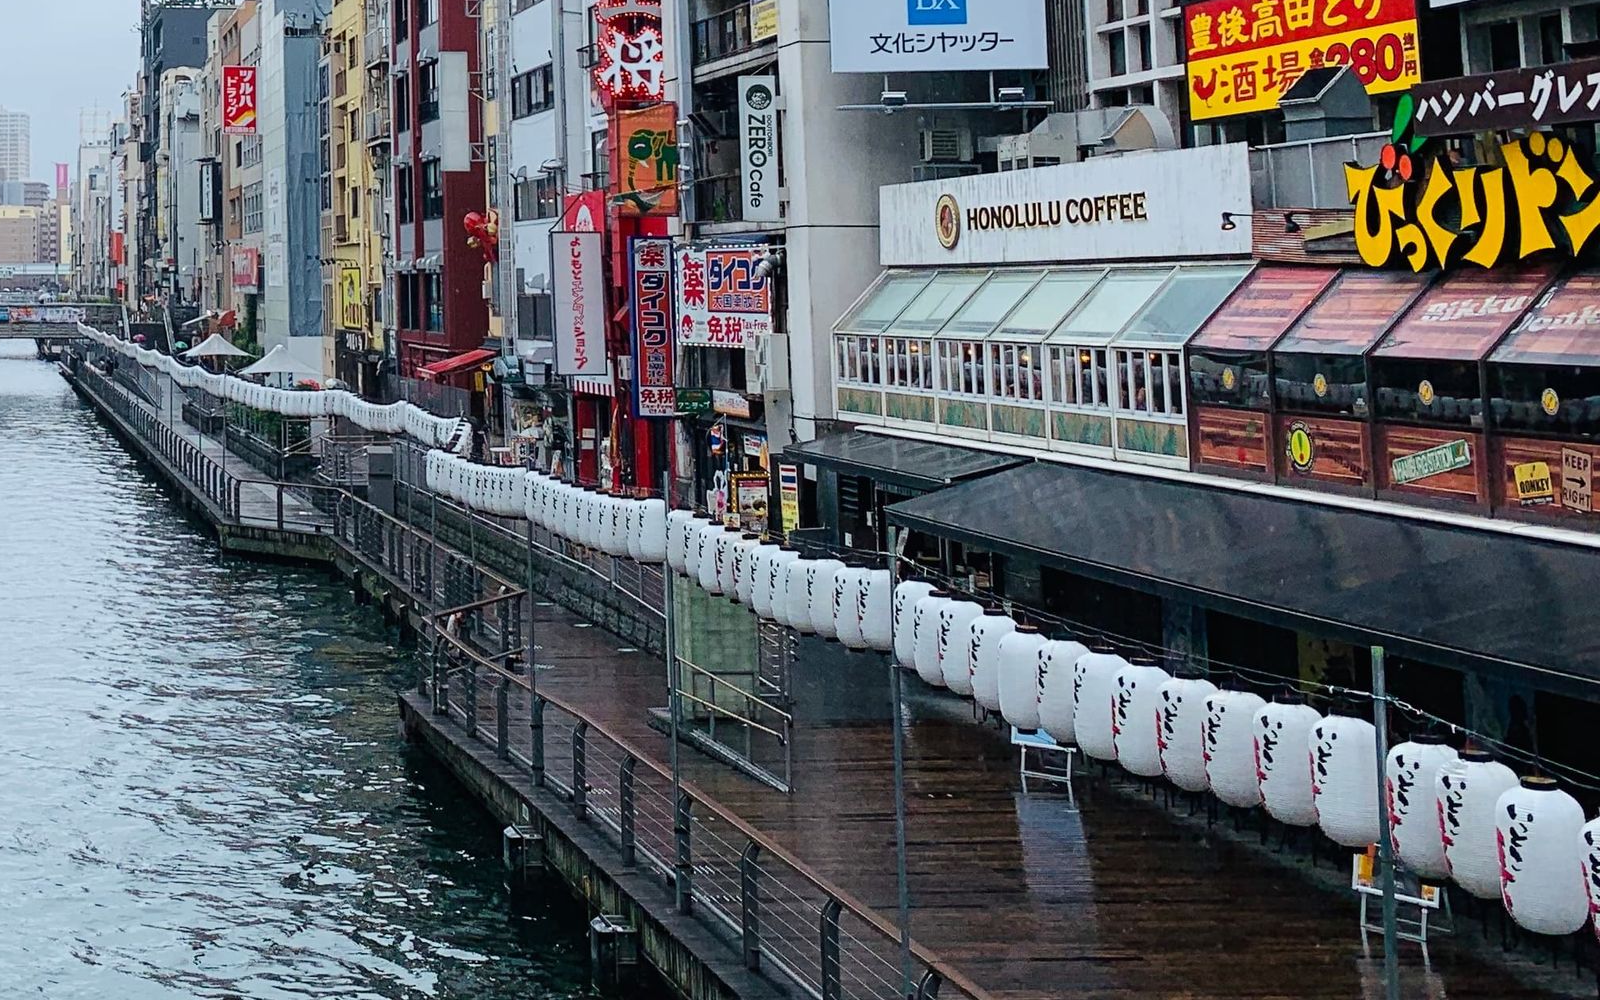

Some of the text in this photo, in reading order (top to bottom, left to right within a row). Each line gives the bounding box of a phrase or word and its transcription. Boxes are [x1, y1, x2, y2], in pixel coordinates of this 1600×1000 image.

[226, 75, 239, 117] ドラッグ
[239, 68, 254, 108] ツルハ
[1222, 53, 1301, 104] 酒場
[747, 113, 767, 208] ZERO cafe
[966, 191, 1149, 232] HONOLULU COFFEE
[640, 273, 667, 348] ダイコク
[707, 316, 743, 343] 免税
[640, 388, 673, 404] 免税
[1564, 454, 1590, 471] KEEP
[1562, 490, 1592, 508] RIGHT
